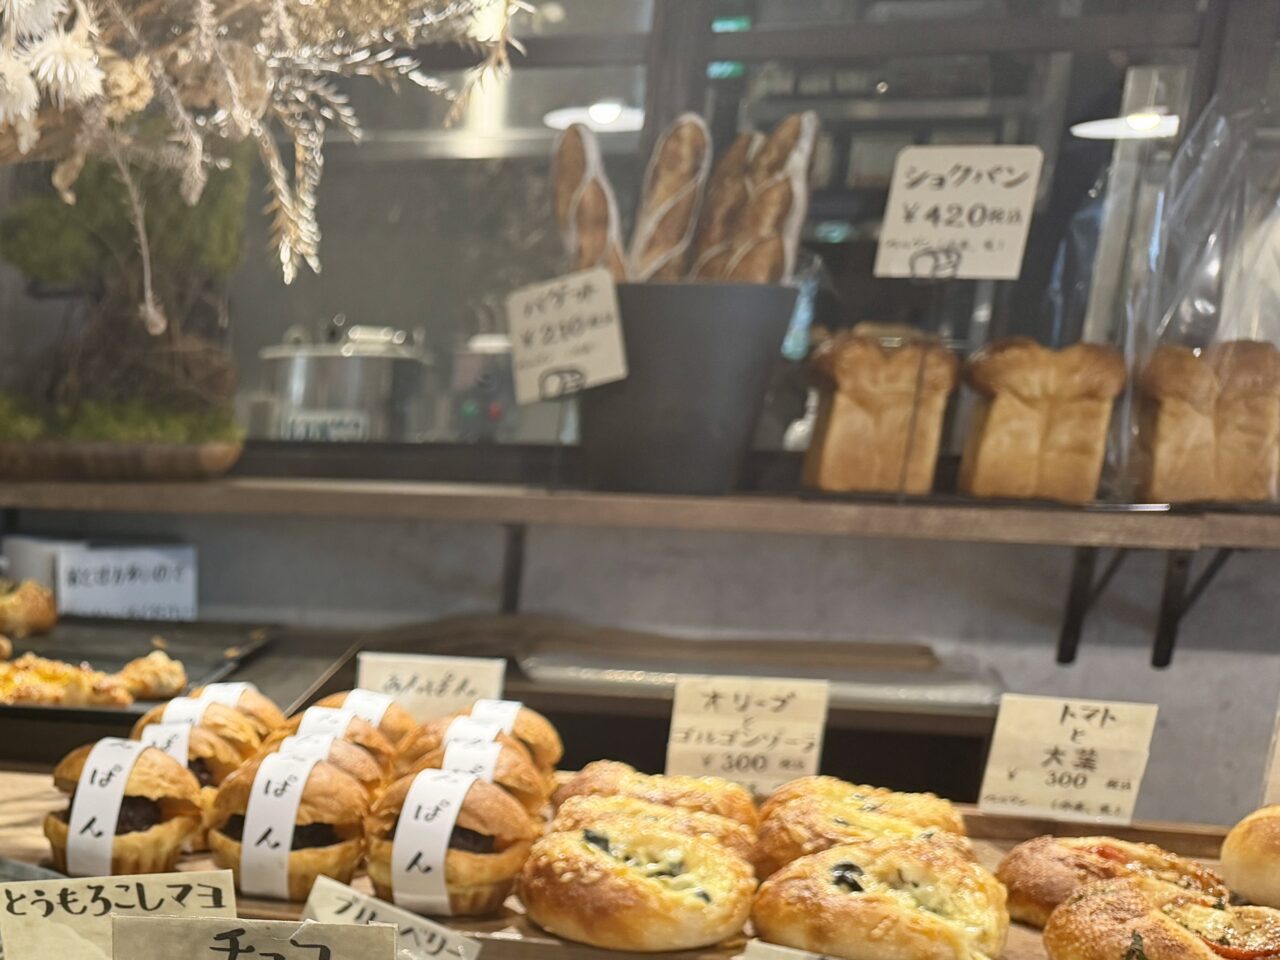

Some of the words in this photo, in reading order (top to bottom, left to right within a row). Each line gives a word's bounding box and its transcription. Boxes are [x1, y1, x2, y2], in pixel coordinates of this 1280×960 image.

[701, 690, 797, 713] オリーブ
[1060, 703, 1118, 728] トマト
[1070, 728, 1085, 744] と
[721, 754, 768, 773] 300
[1041, 745, 1099, 772] 大葉
[4, 882, 227, 918] とうもろこしマヨ
